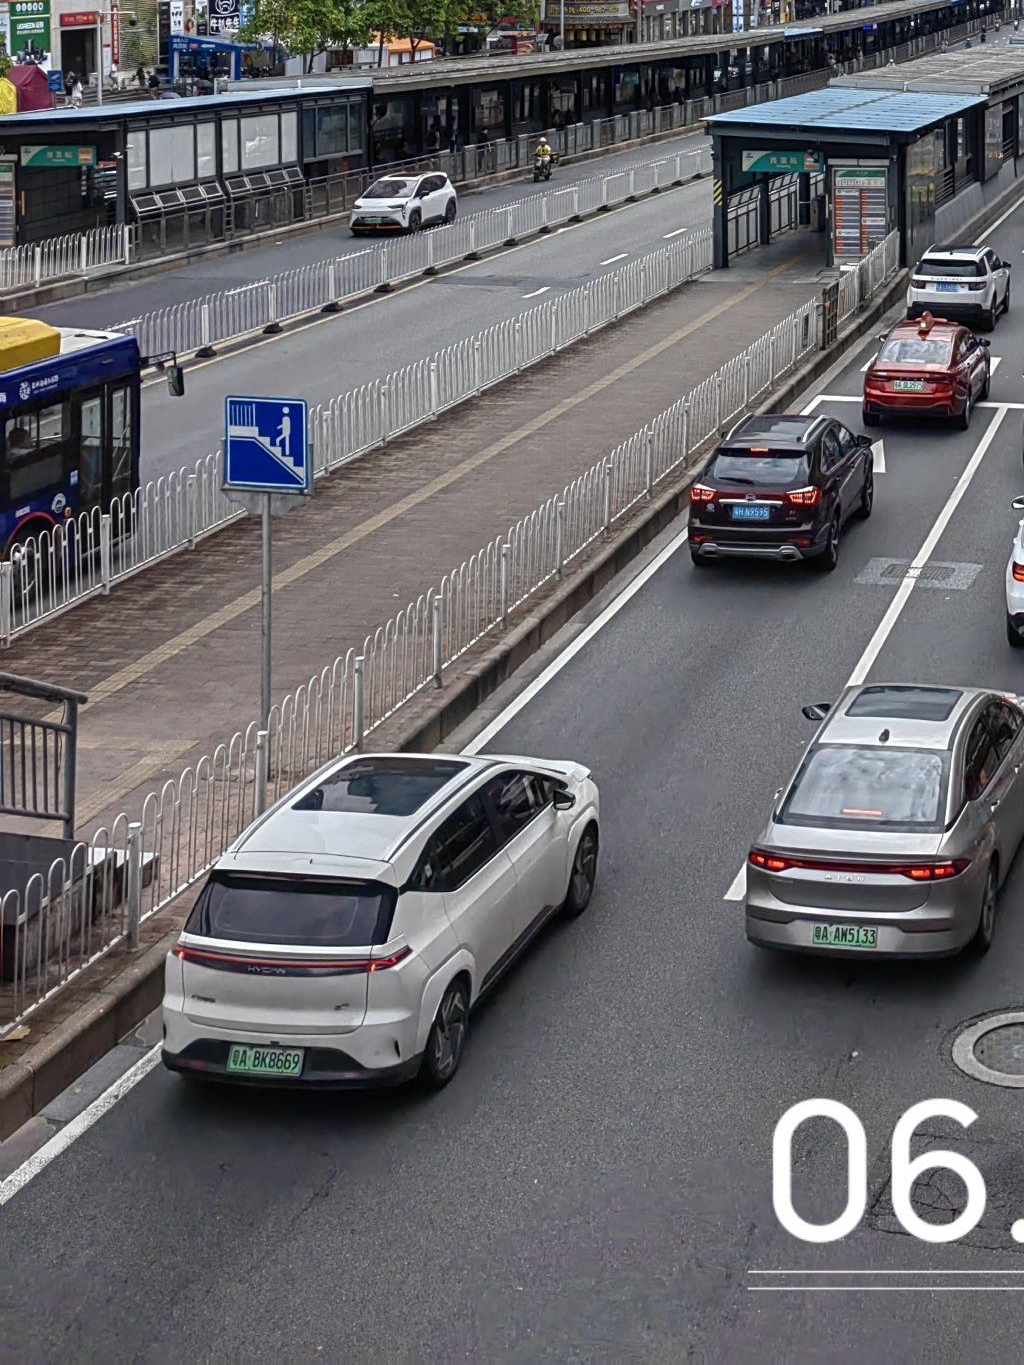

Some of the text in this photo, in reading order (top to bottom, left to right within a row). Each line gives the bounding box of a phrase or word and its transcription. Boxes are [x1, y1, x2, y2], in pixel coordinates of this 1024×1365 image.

[17, 23, 36, 31] UGREEN
[825, 873, 865, 882] AION
[833, 926, 876, 945] AW5133
[252, 1050, 301, 1072] BK8669
